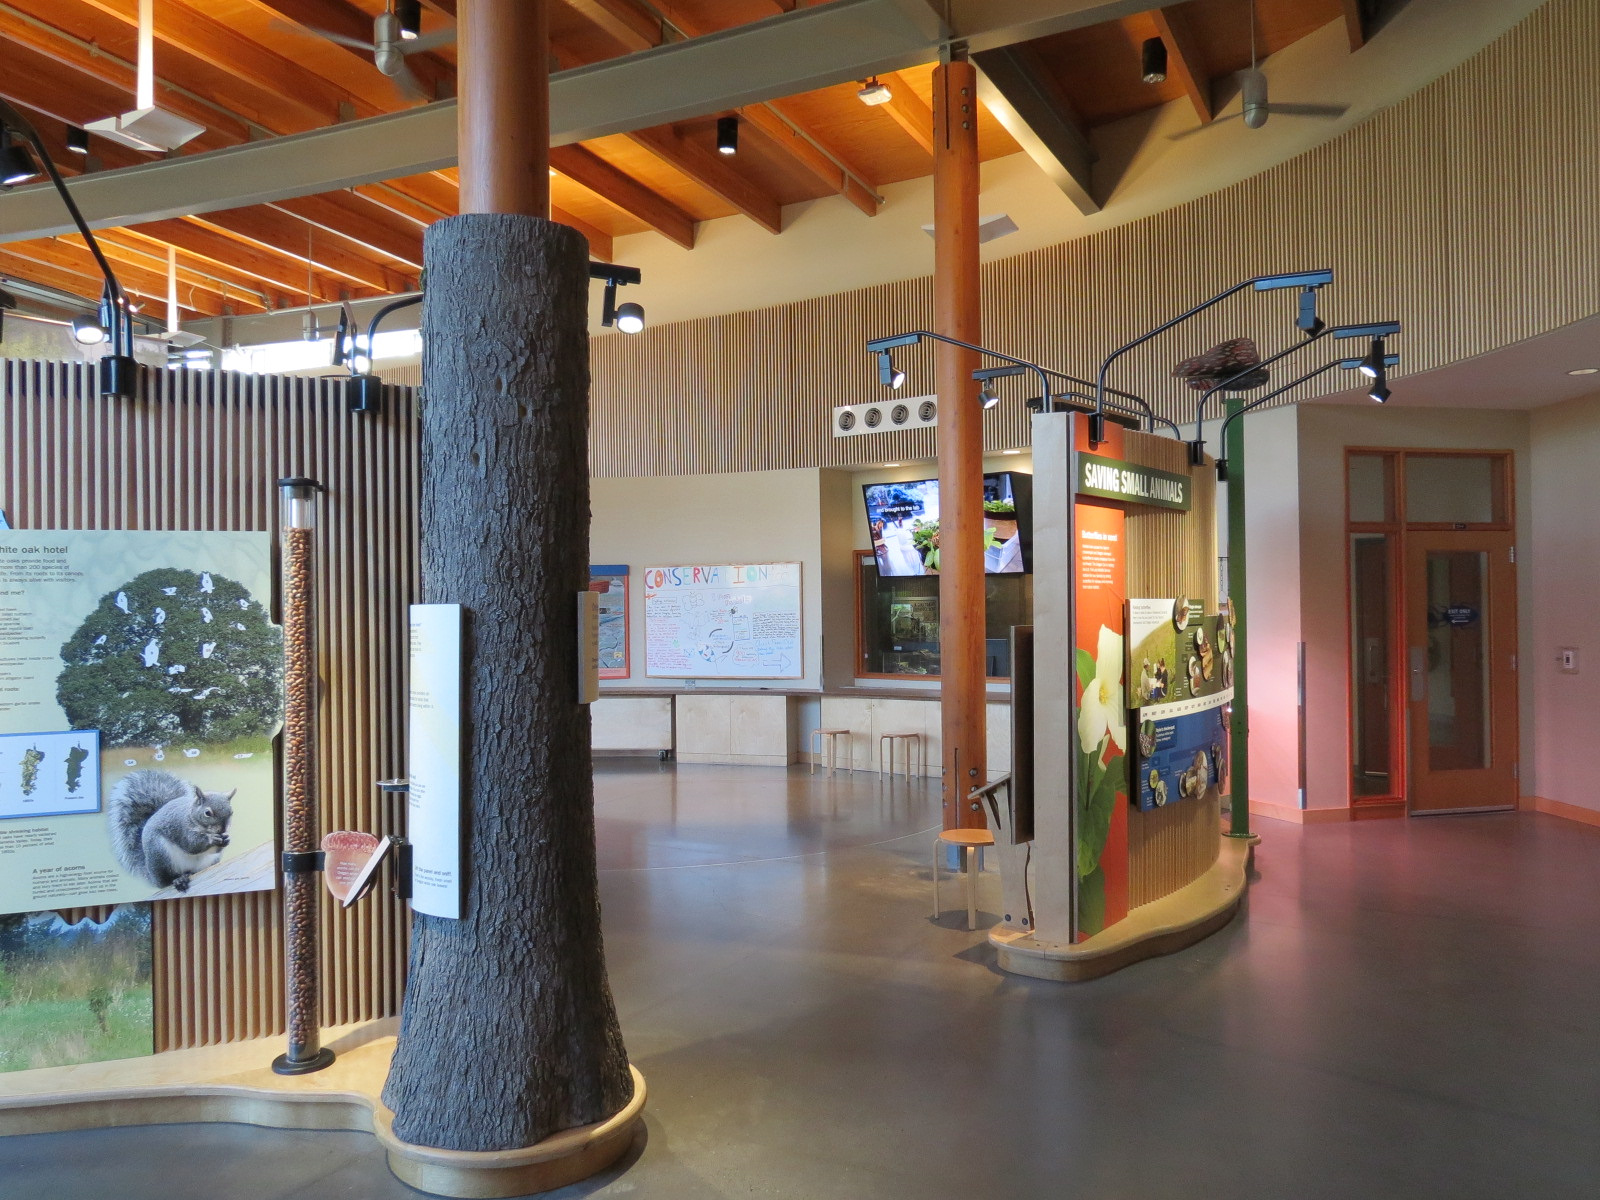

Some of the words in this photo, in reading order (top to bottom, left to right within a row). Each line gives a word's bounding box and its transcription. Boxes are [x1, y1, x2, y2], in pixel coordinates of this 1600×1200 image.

[1085, 462, 1120, 492] SAVING
[1121, 470, 1149, 497] SMALL
[1150, 477, 1183, 504] ANIMALS
[21, 546, 40, 554] oak
[43, 546, 68, 554] hotel
